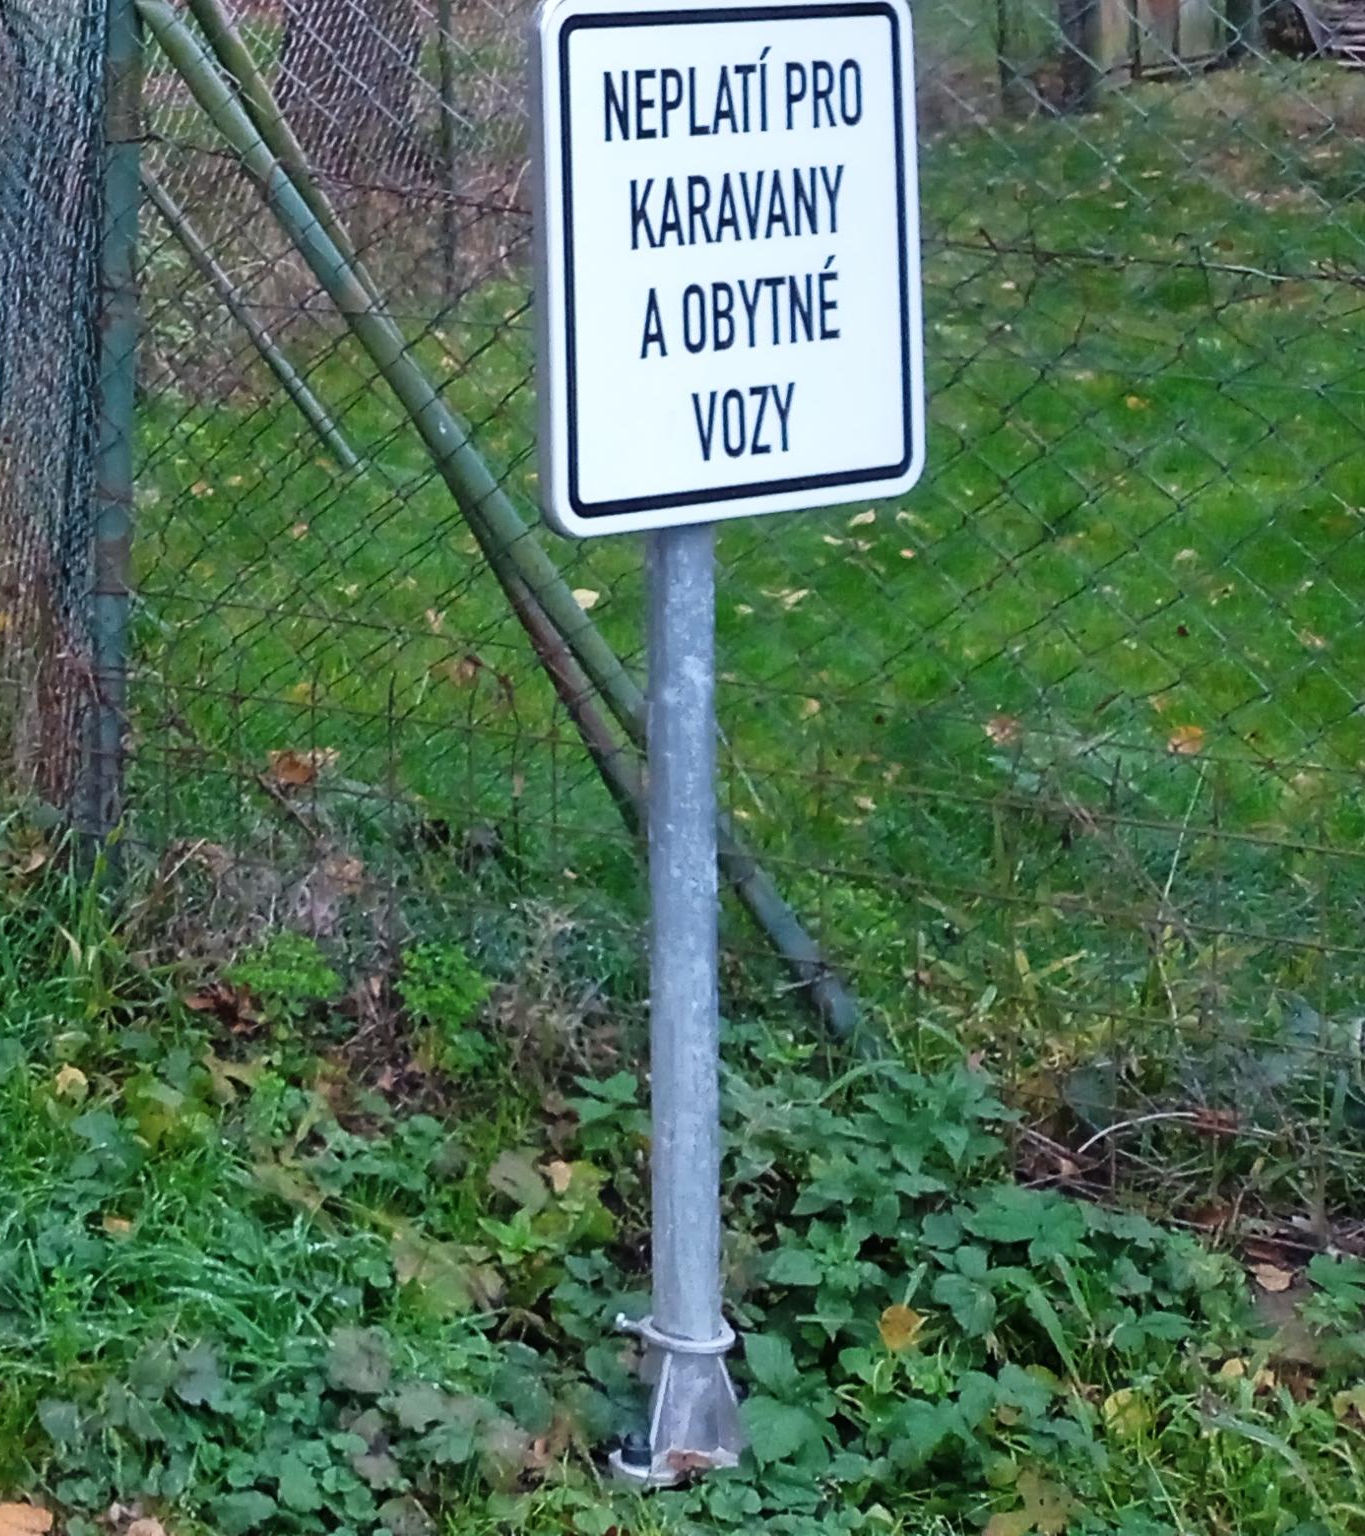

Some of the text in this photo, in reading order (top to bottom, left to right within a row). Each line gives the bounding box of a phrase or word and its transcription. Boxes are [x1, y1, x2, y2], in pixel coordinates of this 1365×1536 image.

[603, 46, 862, 142] NEPLATÍ PRO
[630, 164, 845, 250] KARAVANY
[640, 255, 841, 359] A OBYTNÉ
[691, 382, 796, 461] VOZY
